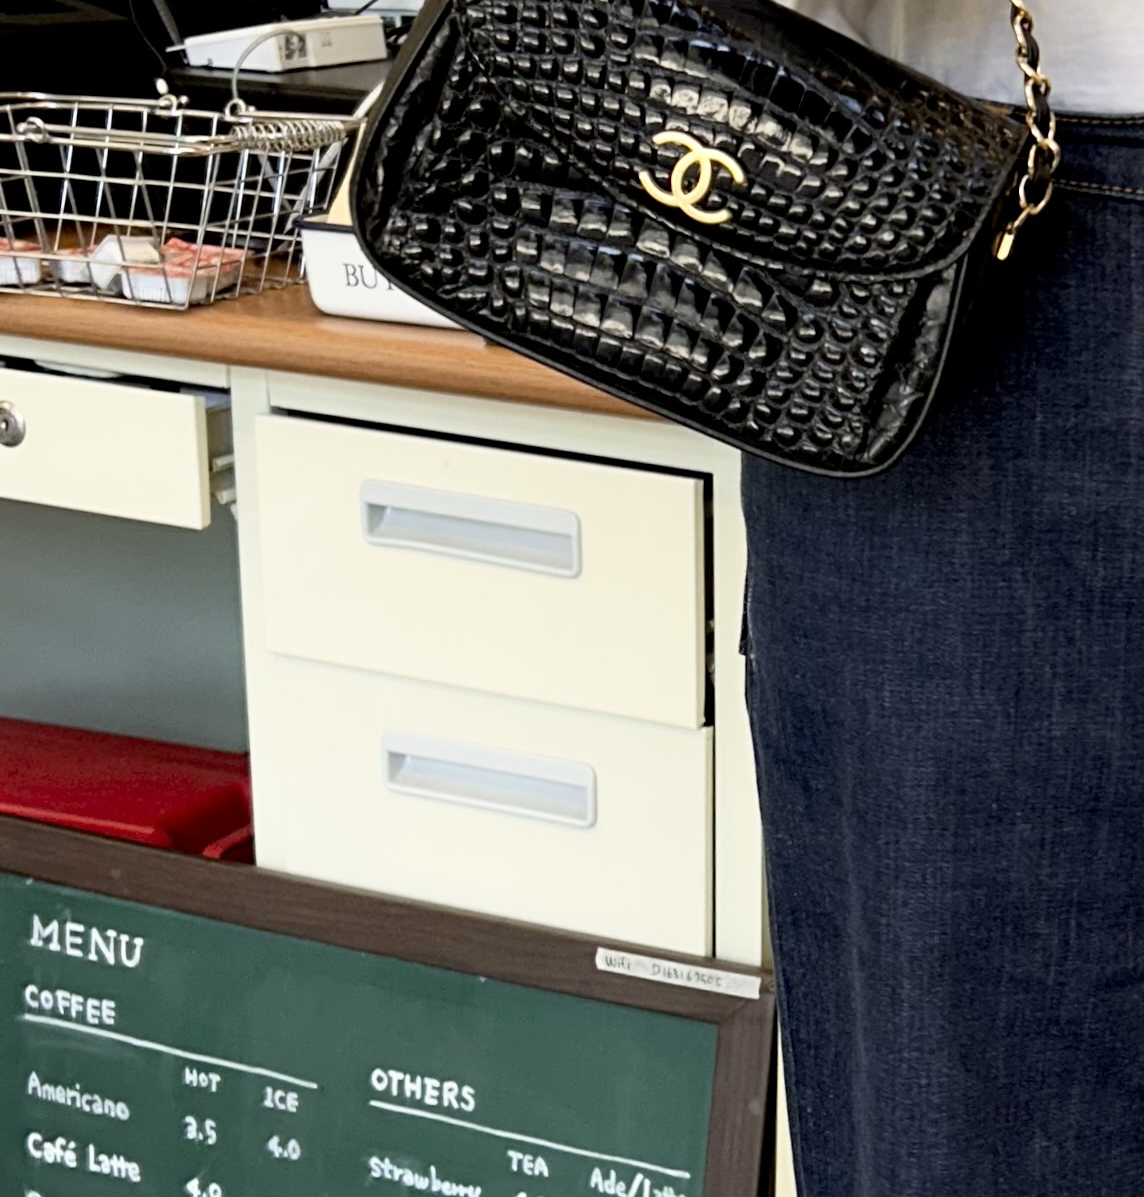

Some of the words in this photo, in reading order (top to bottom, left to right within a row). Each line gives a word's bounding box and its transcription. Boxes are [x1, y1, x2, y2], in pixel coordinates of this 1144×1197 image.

[342, 262, 395, 291] BU
[29, 913, 145, 968] MENU
[24, 984, 117, 1026] COFFEE
[183, 1066, 222, 1093] HOT
[262, 1086, 300, 1113] ICE
[370, 1068, 476, 1112] OTHERS
[26, 1070, 131, 1121] Americano
[183, 1114, 218, 1146] 3.5
[266, 1134, 302, 1161] 4.0
[27, 1131, 78, 1168] Café
[87, 1143, 142, 1183] Latte
[506, 1149, 550, 1178] TEA
